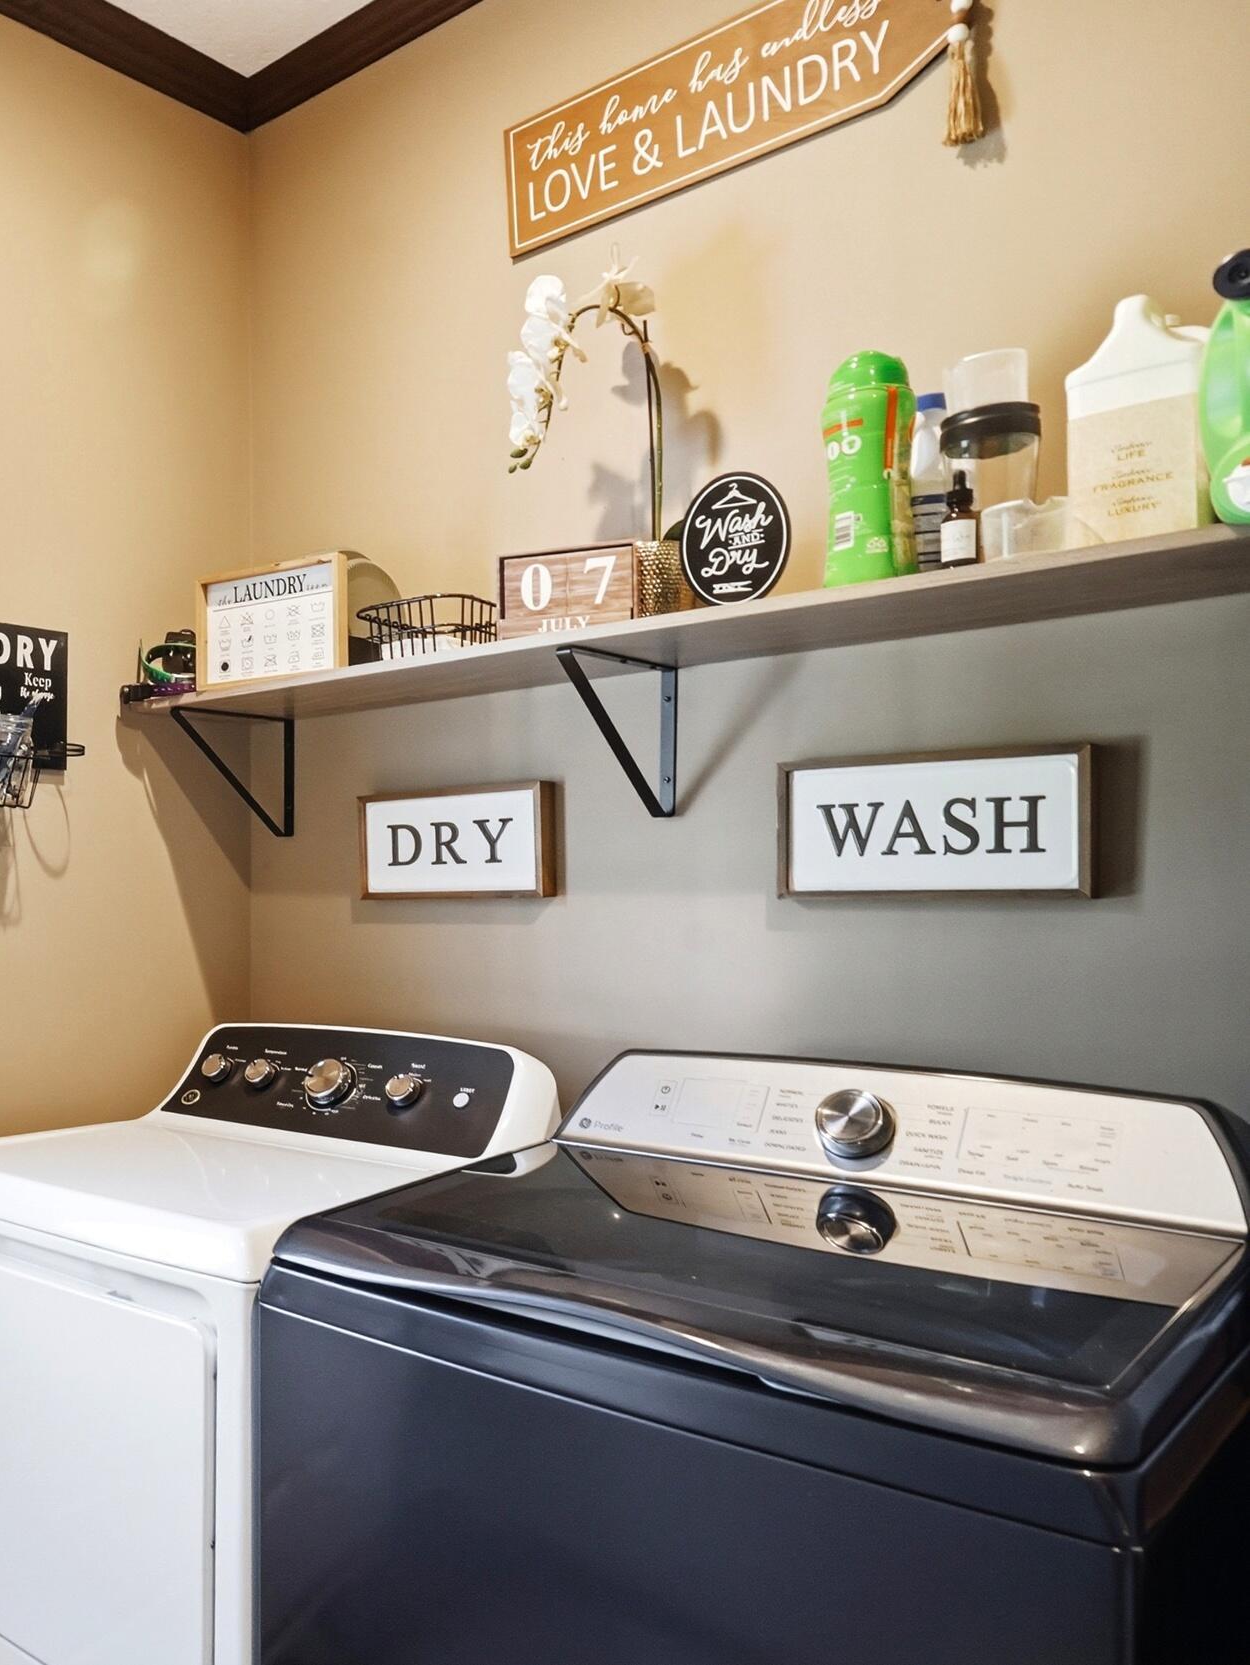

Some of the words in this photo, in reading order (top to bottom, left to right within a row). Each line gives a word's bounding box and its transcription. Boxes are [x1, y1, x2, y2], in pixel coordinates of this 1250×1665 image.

[527, 118, 590, 170] this
[600, 88, 678, 135] home
[689, 51, 749, 91] has
[761, 0, 882, 57] endless
[528, 145, 619, 222] LOVE
[633, 129, 664, 176] &
[676, 20, 890, 160] LAUNDRY
[695, 501, 774, 550] Wash
[732, 532, 760, 546] AND
[520, 563, 553, 612] 0
[583, 555, 616, 605] 7
[700, 547, 770, 577] Dry
[233, 573, 307, 604] LAUNDRY
[537, 615, 591, 633] JULY
[24, 672, 52, 691] Keep
[387, 817, 513, 867] DRY
[816, 795, 1047, 858] WASH
